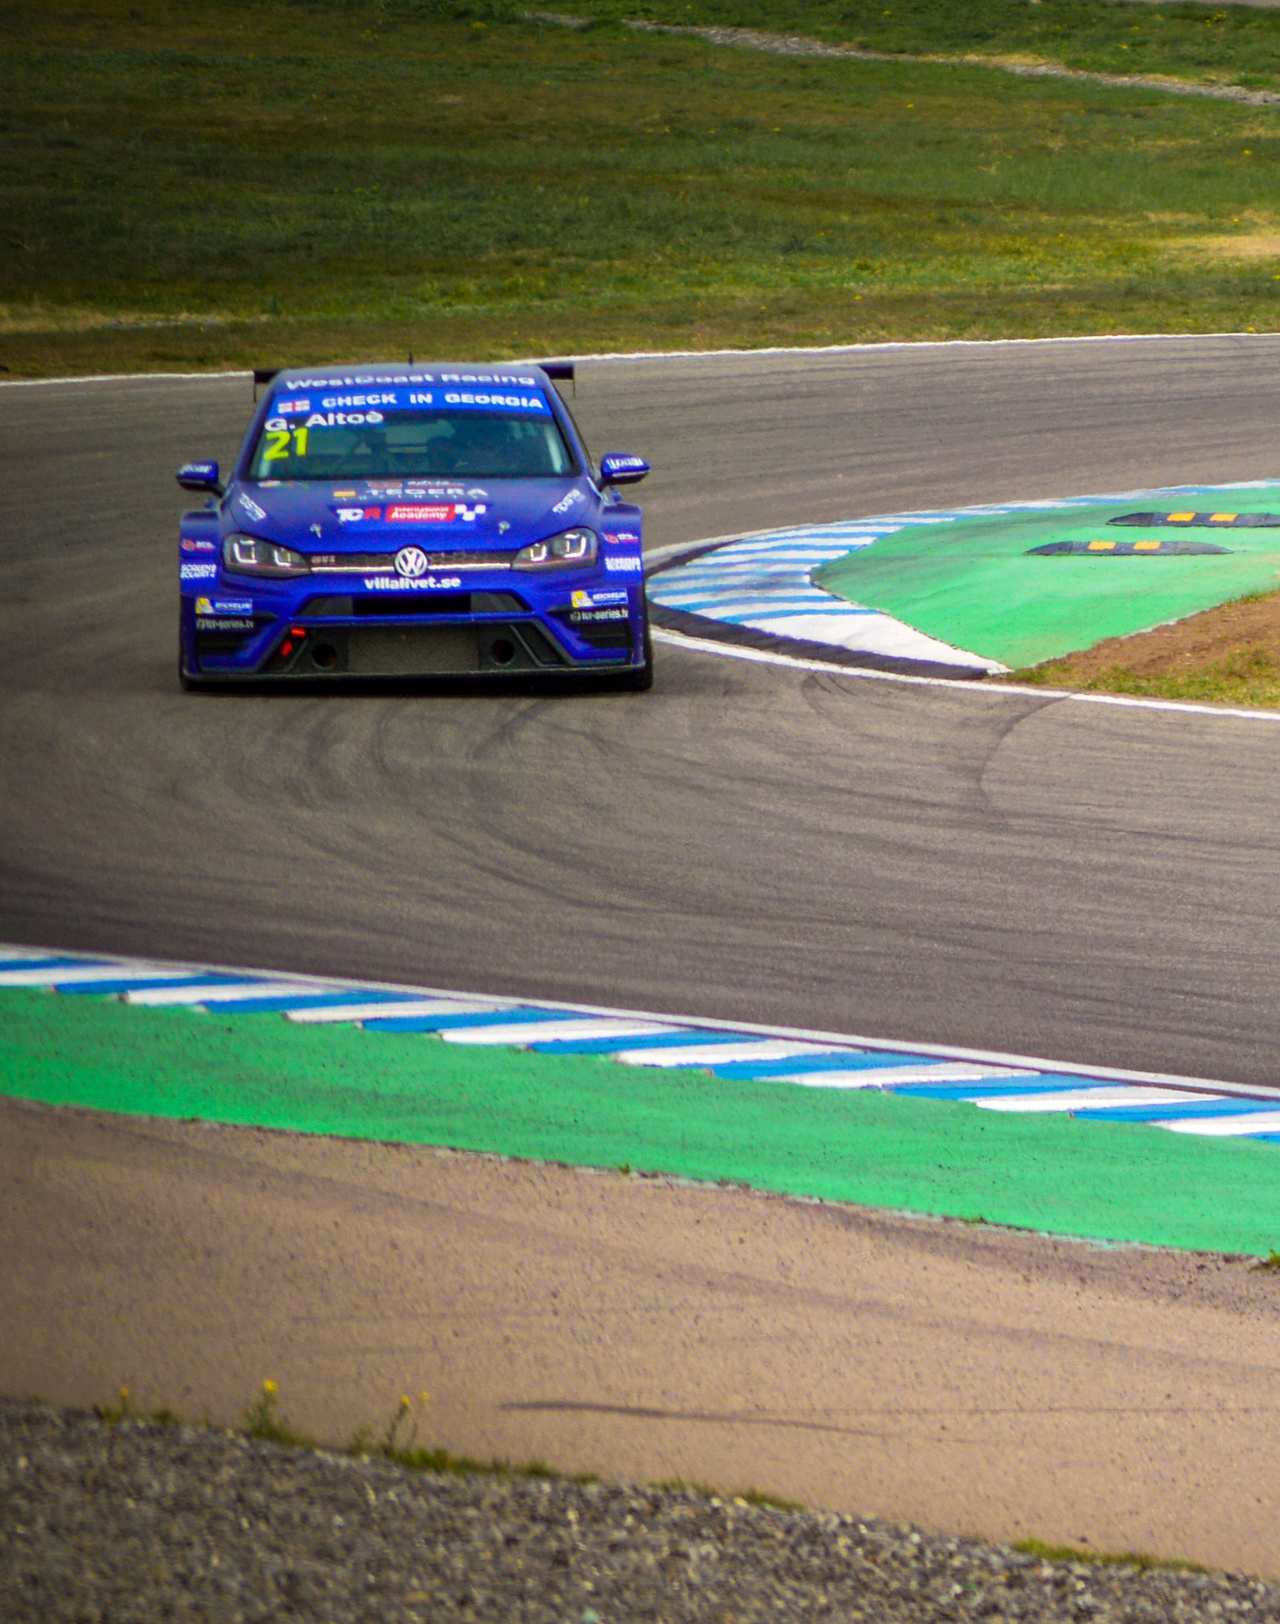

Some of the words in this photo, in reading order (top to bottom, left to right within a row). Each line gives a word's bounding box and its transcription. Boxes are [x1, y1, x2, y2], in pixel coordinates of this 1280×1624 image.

[286, 373, 434, 390] WestCoast
[440, 373, 536, 386] Racing
[321, 394, 398, 408] CHECK
[409, 393, 433, 405] IN
[444, 393, 544, 408] GEORGIA
[264, 418, 296, 432] G.
[263, 427, 309, 460] 21
[336, 508, 381, 521] TCR
[390, 511, 447, 520] Academy
[364, 577, 462, 589] villalivet.se
